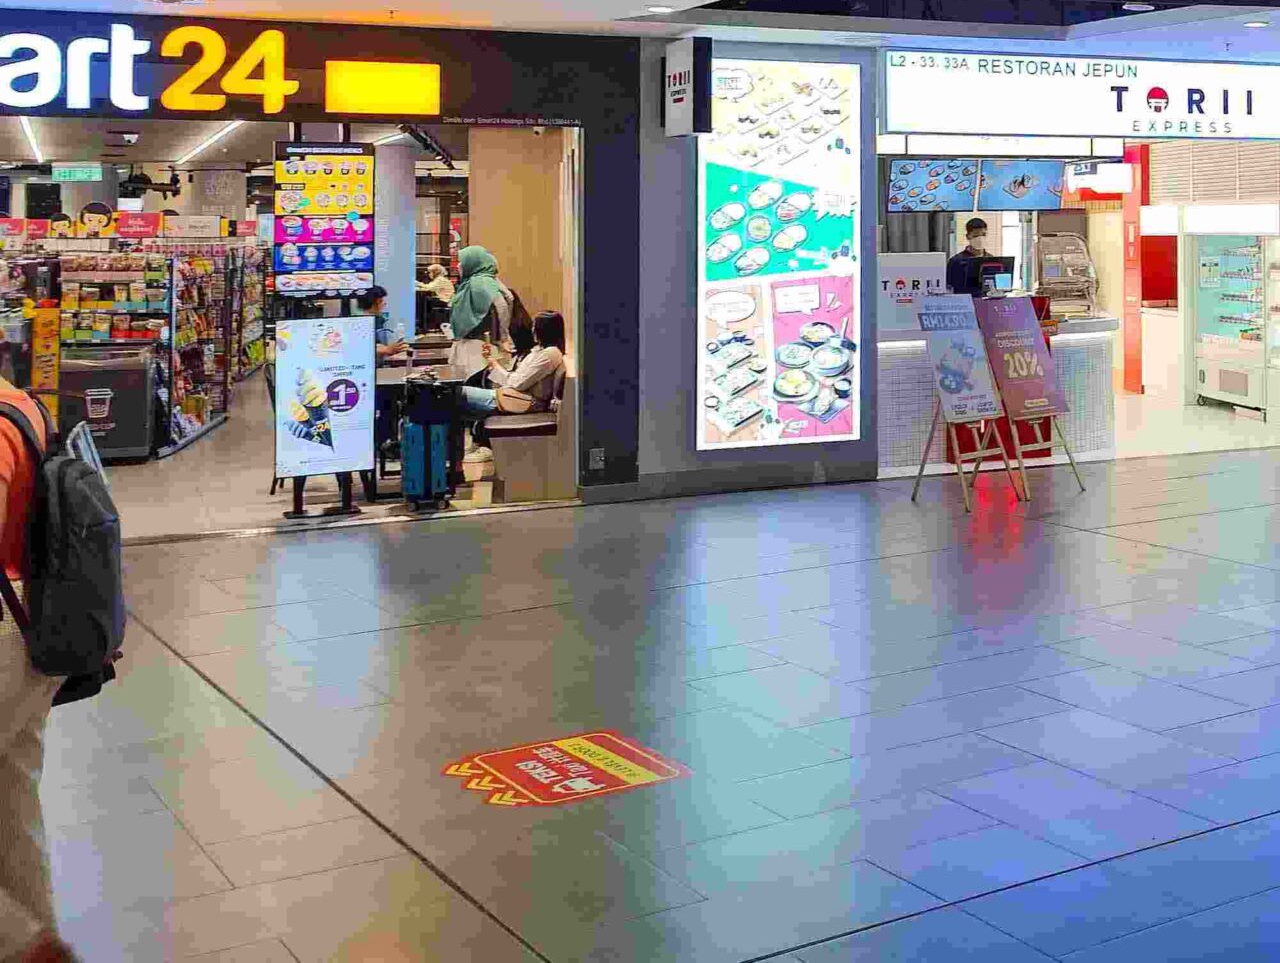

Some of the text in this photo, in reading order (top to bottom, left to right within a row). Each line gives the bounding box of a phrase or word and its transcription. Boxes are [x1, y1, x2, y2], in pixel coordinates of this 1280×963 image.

[889, 54, 907, 68] L2
[943, 57, 969, 72] 33A
[977, 58, 1077, 79] RESTORAN
[1082, 60, 1139, 80] JEPUN
[1110, 85, 1254, 116] TORII
[1132, 119, 1233, 134] EXPRESS
[1003, 352, 1044, 379] 20%
